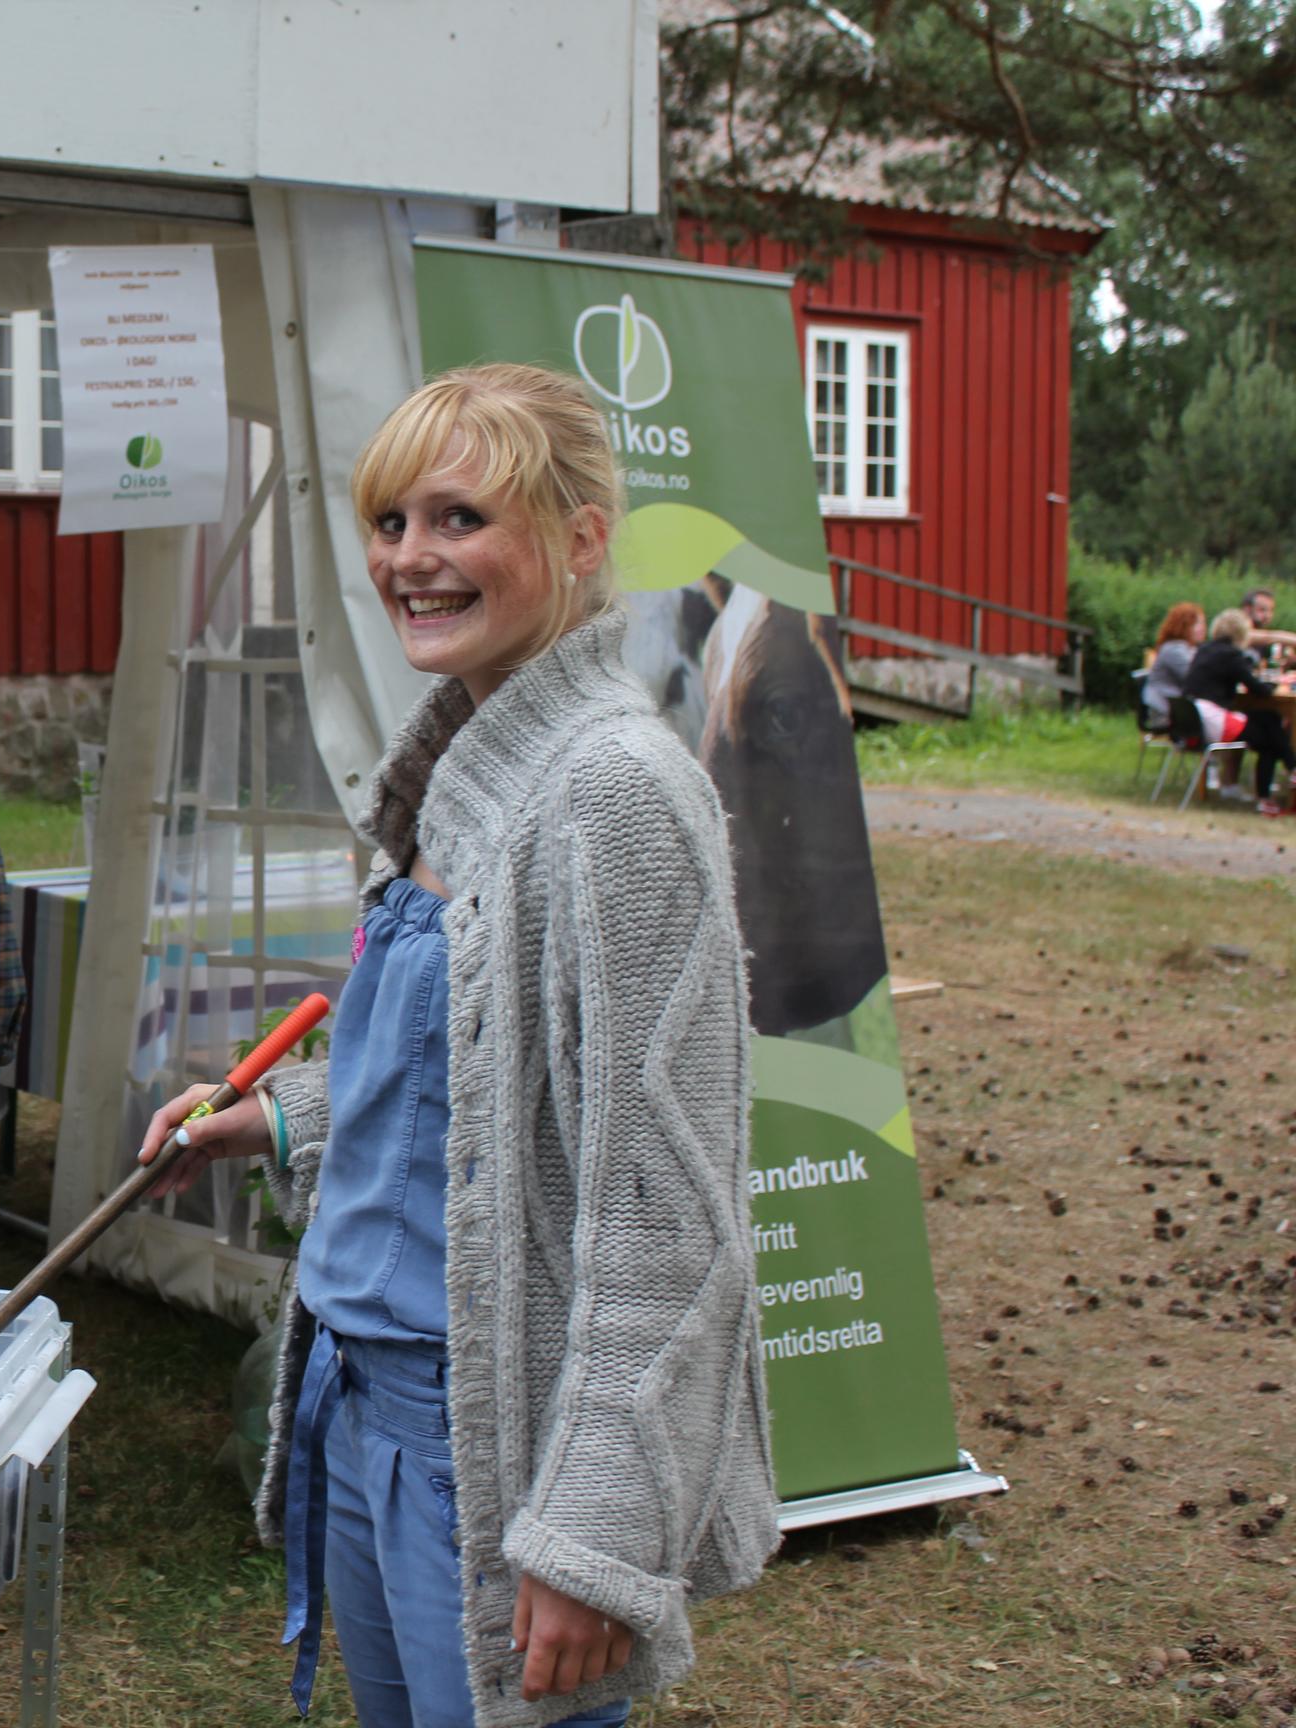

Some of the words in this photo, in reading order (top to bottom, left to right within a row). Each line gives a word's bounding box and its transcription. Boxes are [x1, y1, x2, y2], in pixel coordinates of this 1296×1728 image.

[602, 411, 691, 457] ikos
[120, 473, 168, 489] Oikos
[748, 1150, 868, 1194] andbruk
[753, 1222, 798, 1254] fritt
[756, 1267, 864, 1306] evennlig
[761, 1319, 883, 1361] mtidsretta
